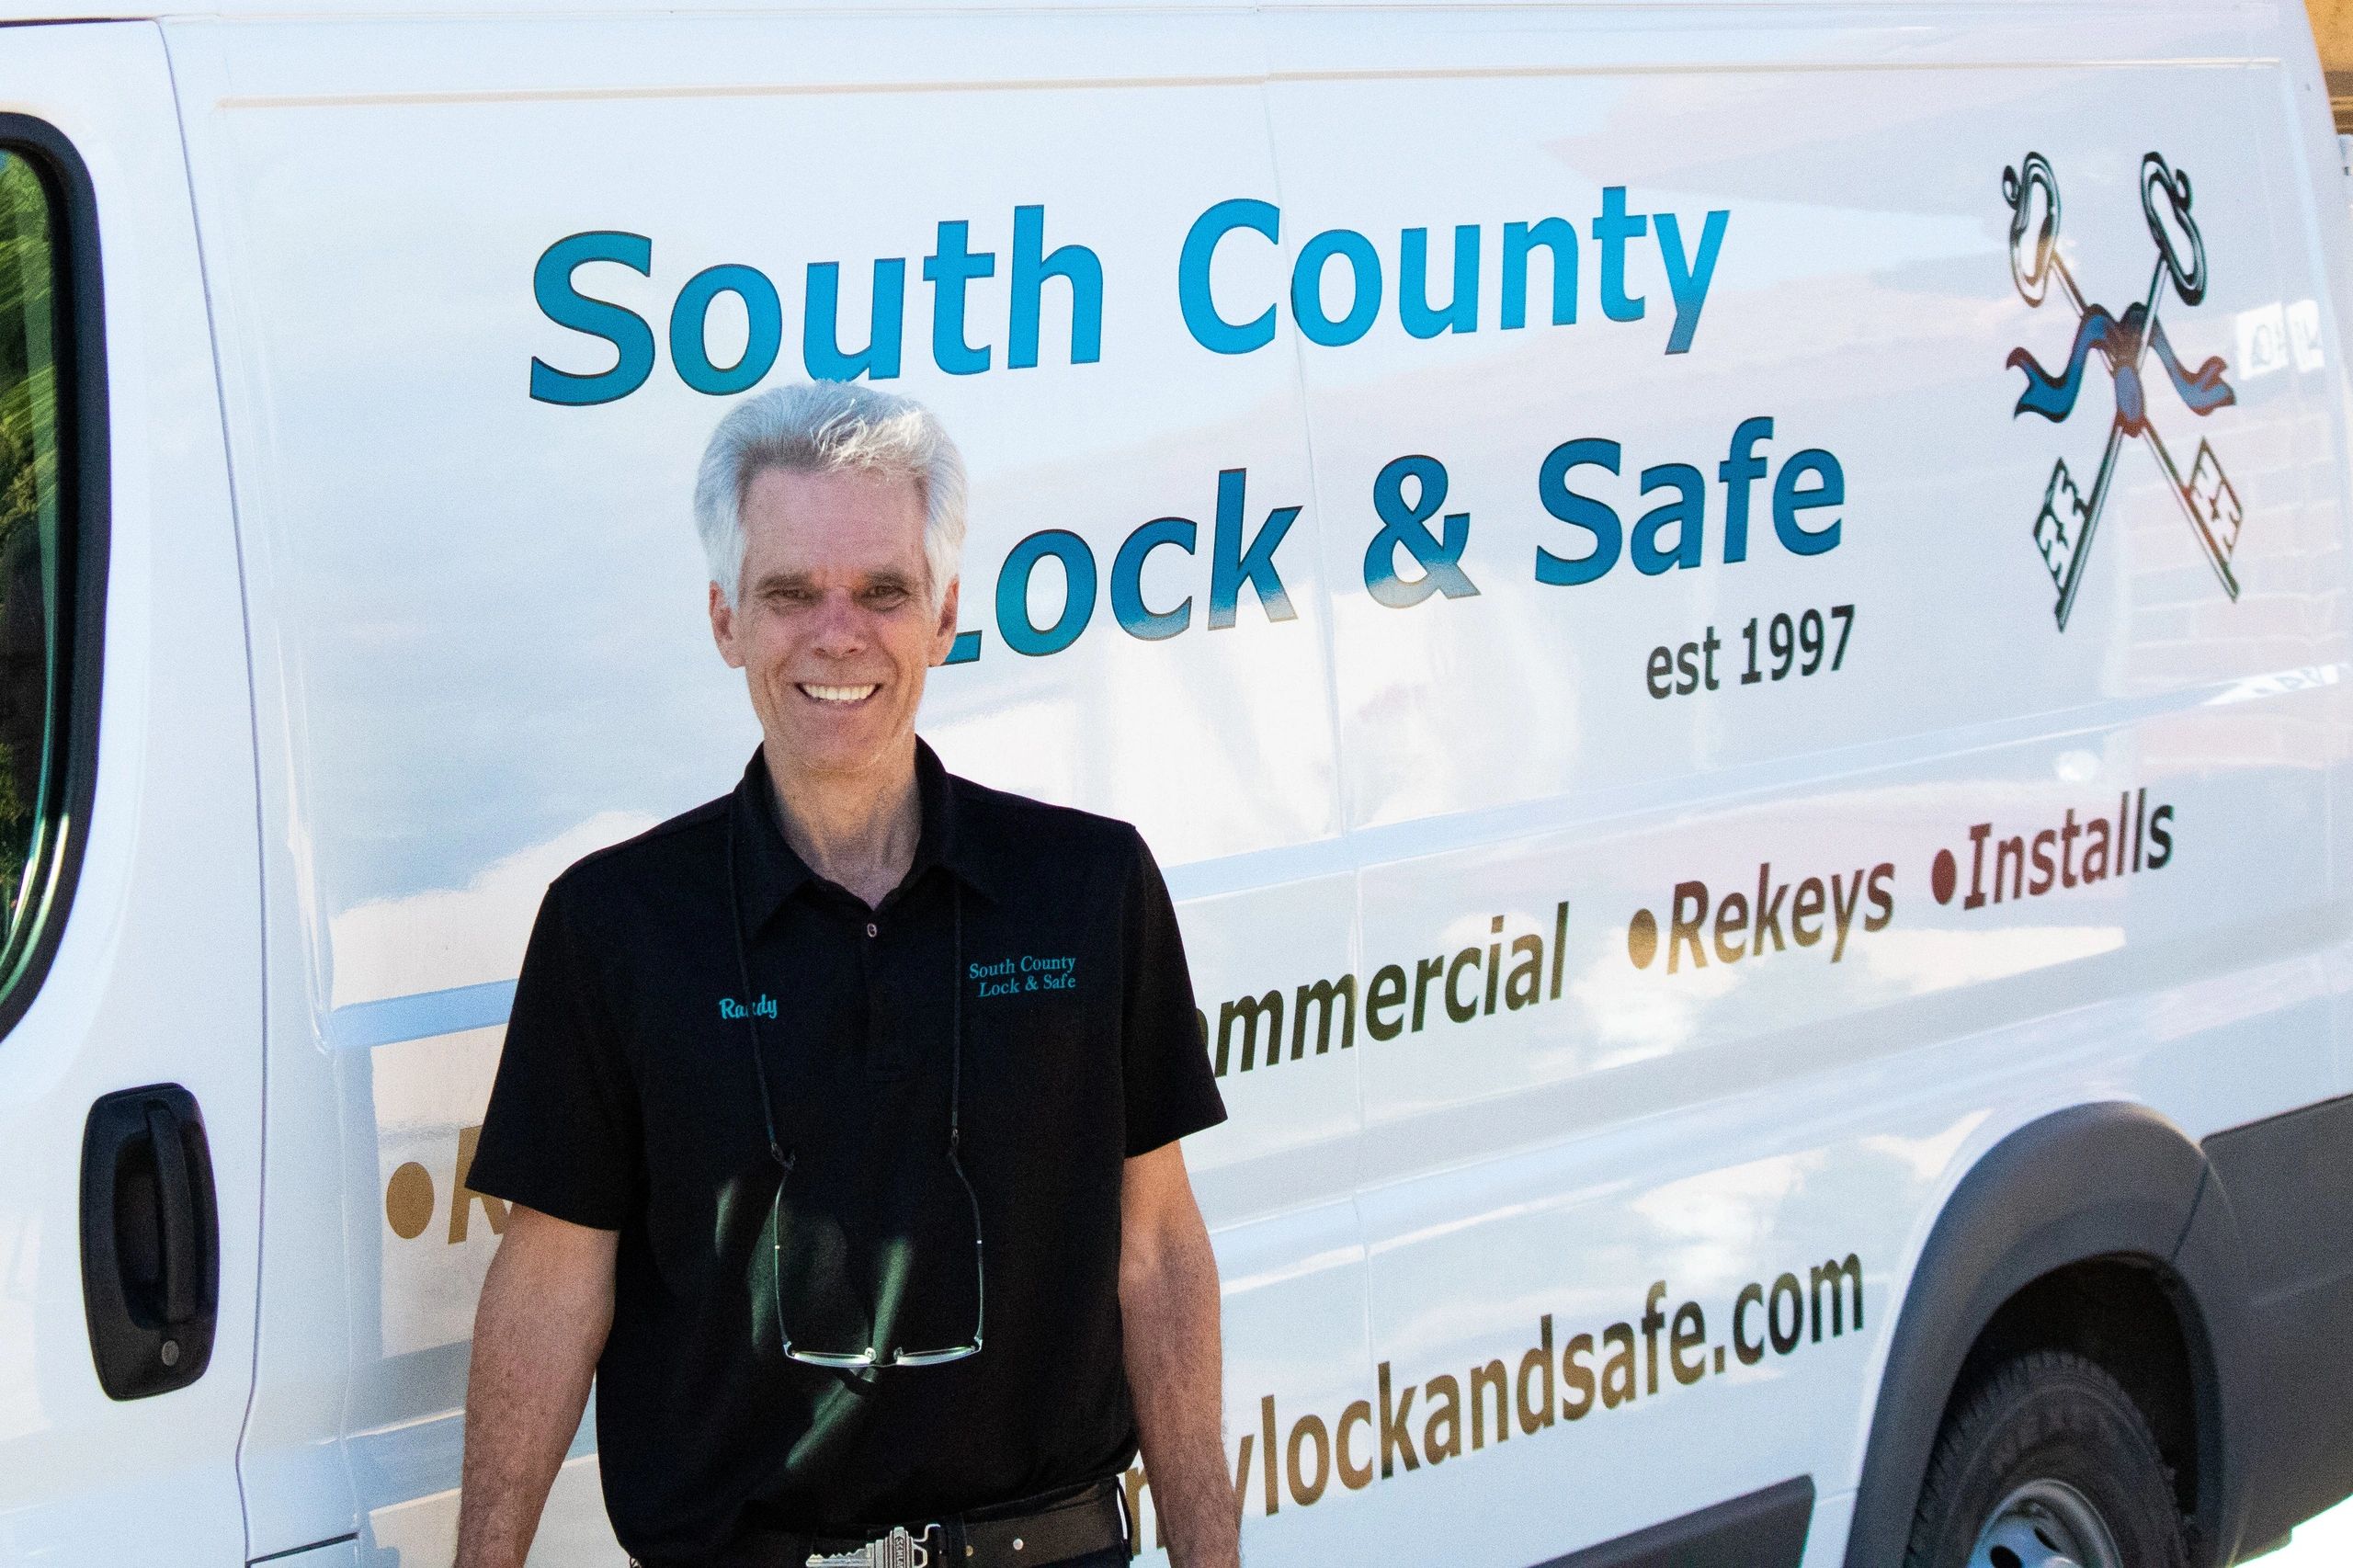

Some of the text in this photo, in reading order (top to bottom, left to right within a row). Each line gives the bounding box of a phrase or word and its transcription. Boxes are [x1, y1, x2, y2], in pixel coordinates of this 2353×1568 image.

[529, 186, 1731, 406] South County
[930, 416, 1846, 667] ock & Safe
[1646, 604, 1856, 699] est 1997
[969, 955, 1076, 979] South County
[978, 973, 1076, 997] Lock & Safe
[1196, 788, 2175, 1078] mmercial Rekeys Installs
